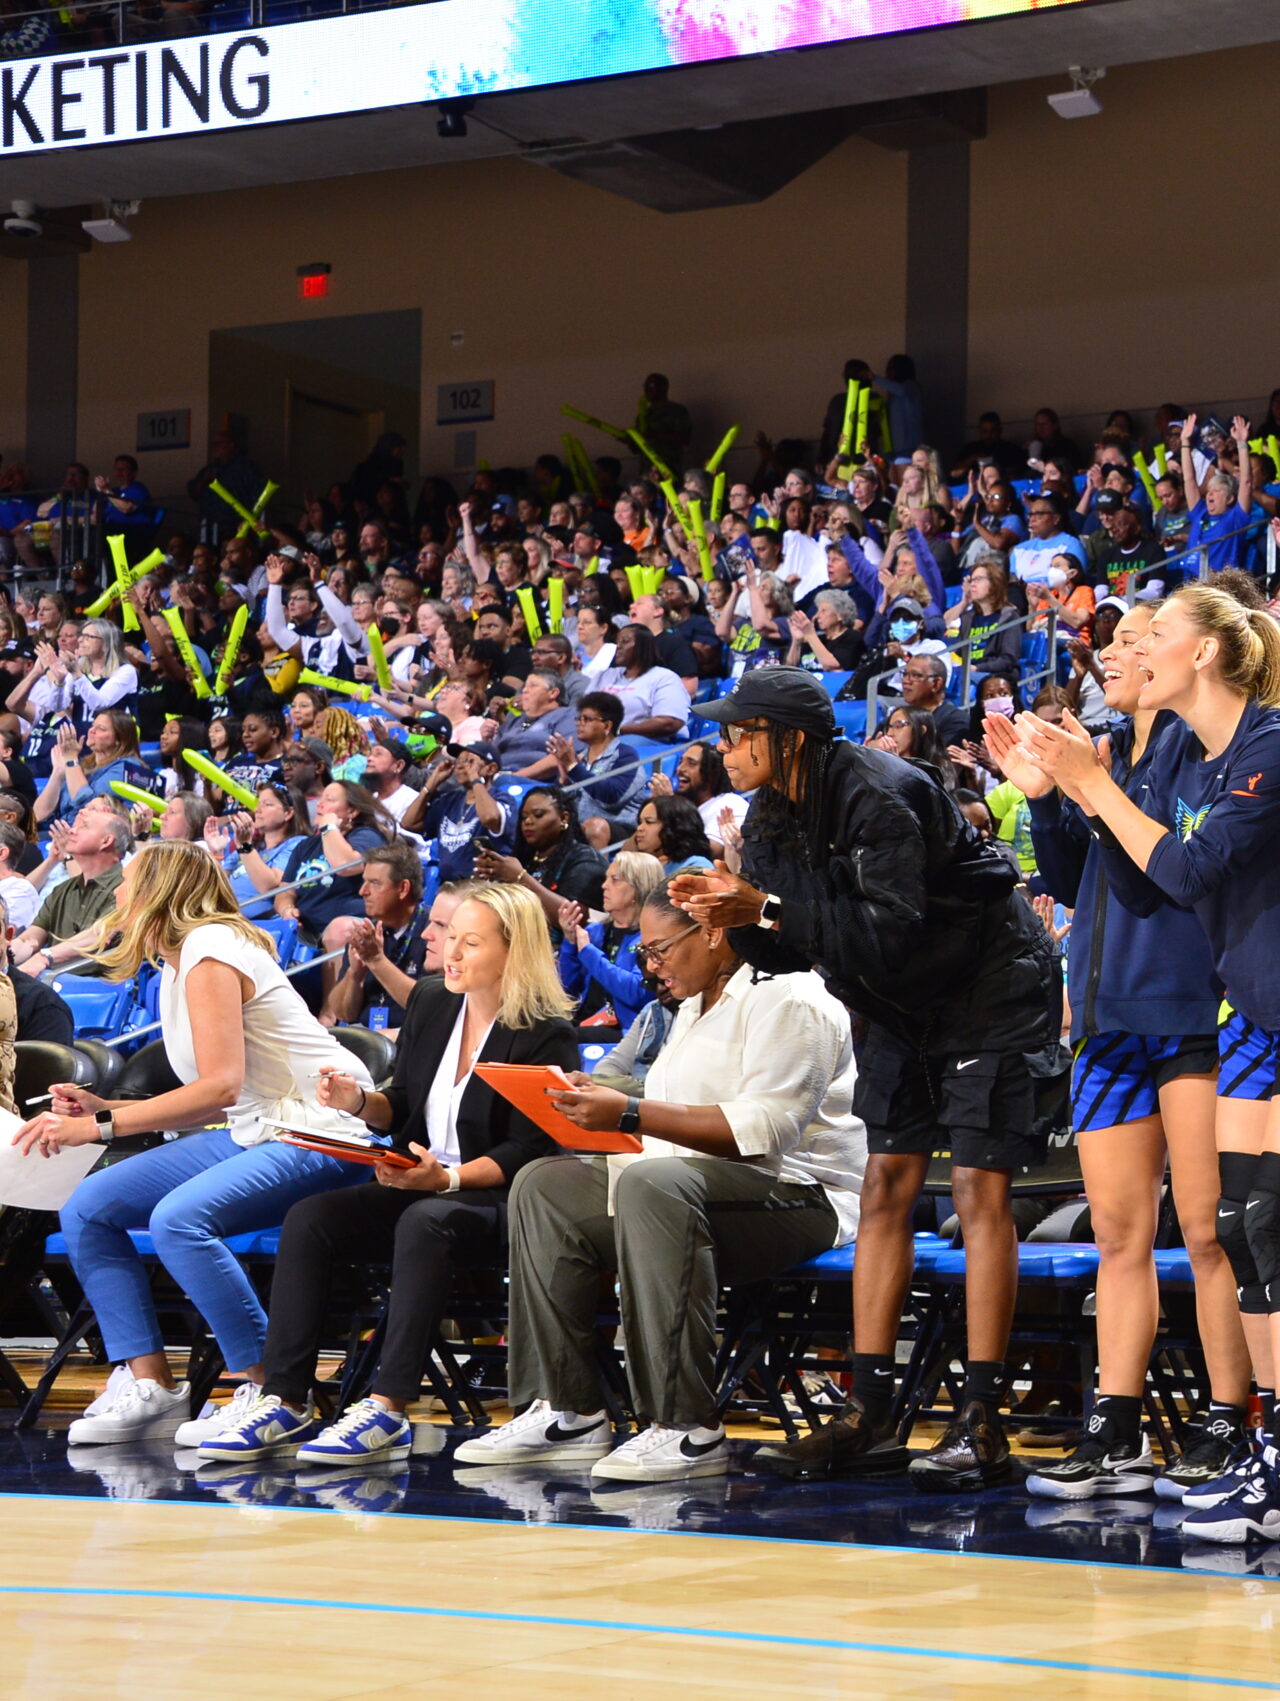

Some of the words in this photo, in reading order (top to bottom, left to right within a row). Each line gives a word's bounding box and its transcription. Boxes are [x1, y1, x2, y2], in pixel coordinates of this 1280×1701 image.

[1, 34, 270, 147] KETING
[449, 388, 482, 410] 102
[148, 416, 178, 439] 101
[27, 737, 42, 757] 12
